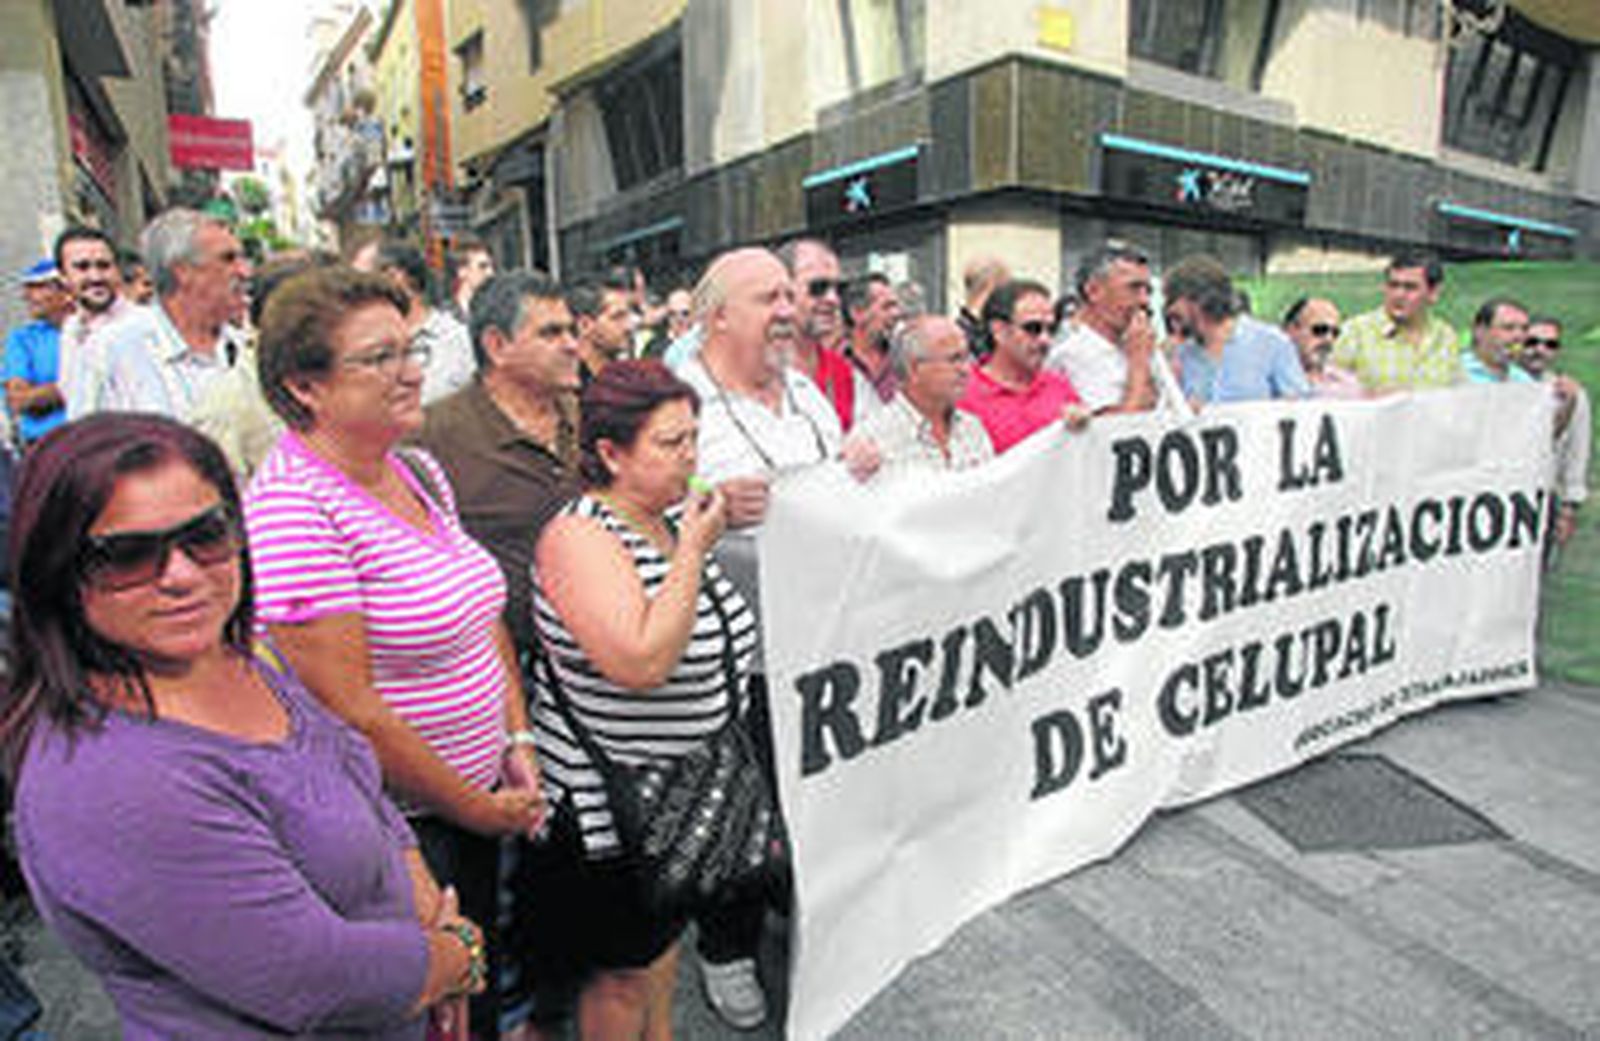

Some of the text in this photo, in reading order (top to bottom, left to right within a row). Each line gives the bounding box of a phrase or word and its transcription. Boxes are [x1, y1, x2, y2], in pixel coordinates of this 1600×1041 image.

[1107, 414, 1343, 523] POR LA
[794, 488, 1545, 778] REINDUSTRIALIZACION
[1030, 687, 1127, 800] DE
[1156, 602, 1396, 738] CELUPAL
